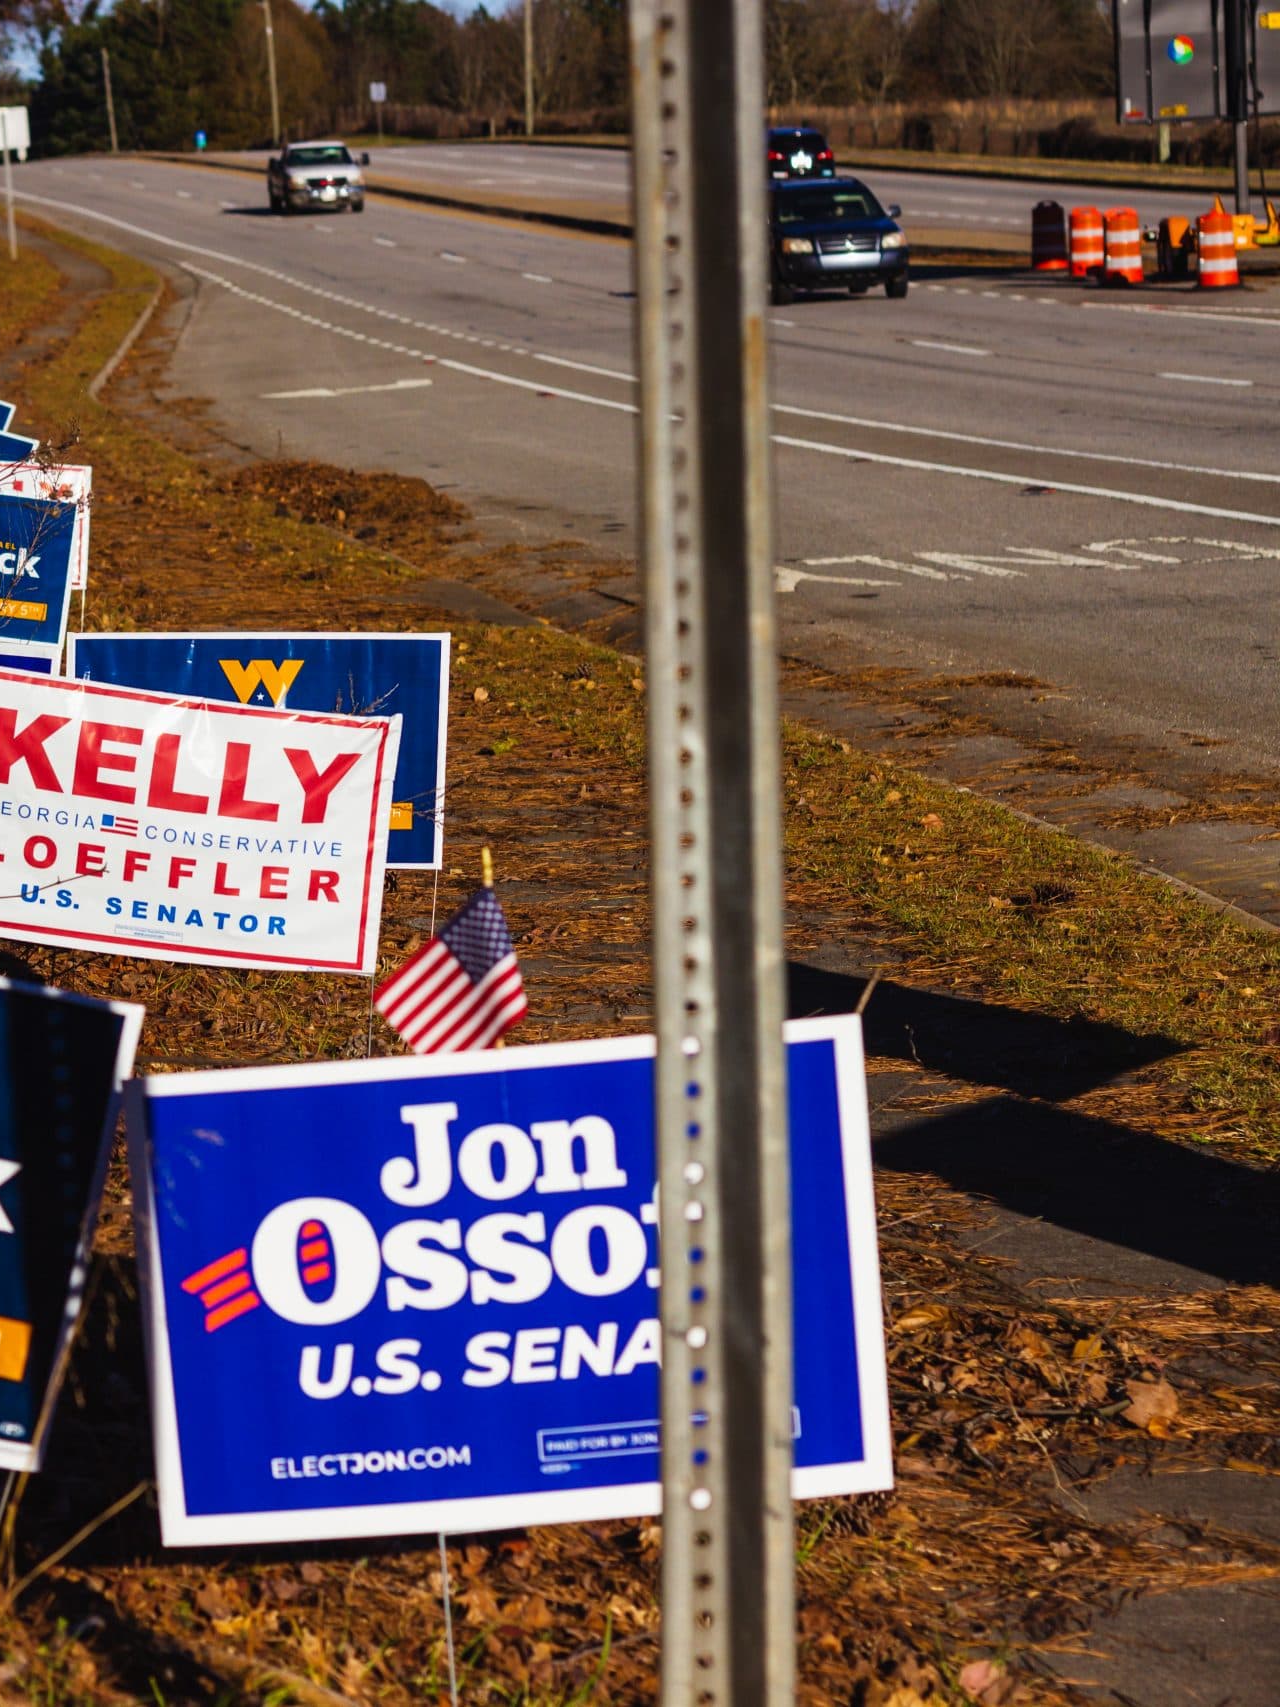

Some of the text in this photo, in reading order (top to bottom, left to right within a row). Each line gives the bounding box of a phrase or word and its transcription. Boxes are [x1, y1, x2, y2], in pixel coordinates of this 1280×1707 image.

[145, 825, 343, 857] CONSERVATIVE
[20, 883, 80, 909] U.S.
[105, 896, 286, 935] SENATOR
[380, 1102, 626, 1207] Jon
[252, 1180, 661, 1326] Osso
[298, 1318, 662, 1399] U.S. SENA
[271, 1444, 471, 1480] ELECTJON.COM
